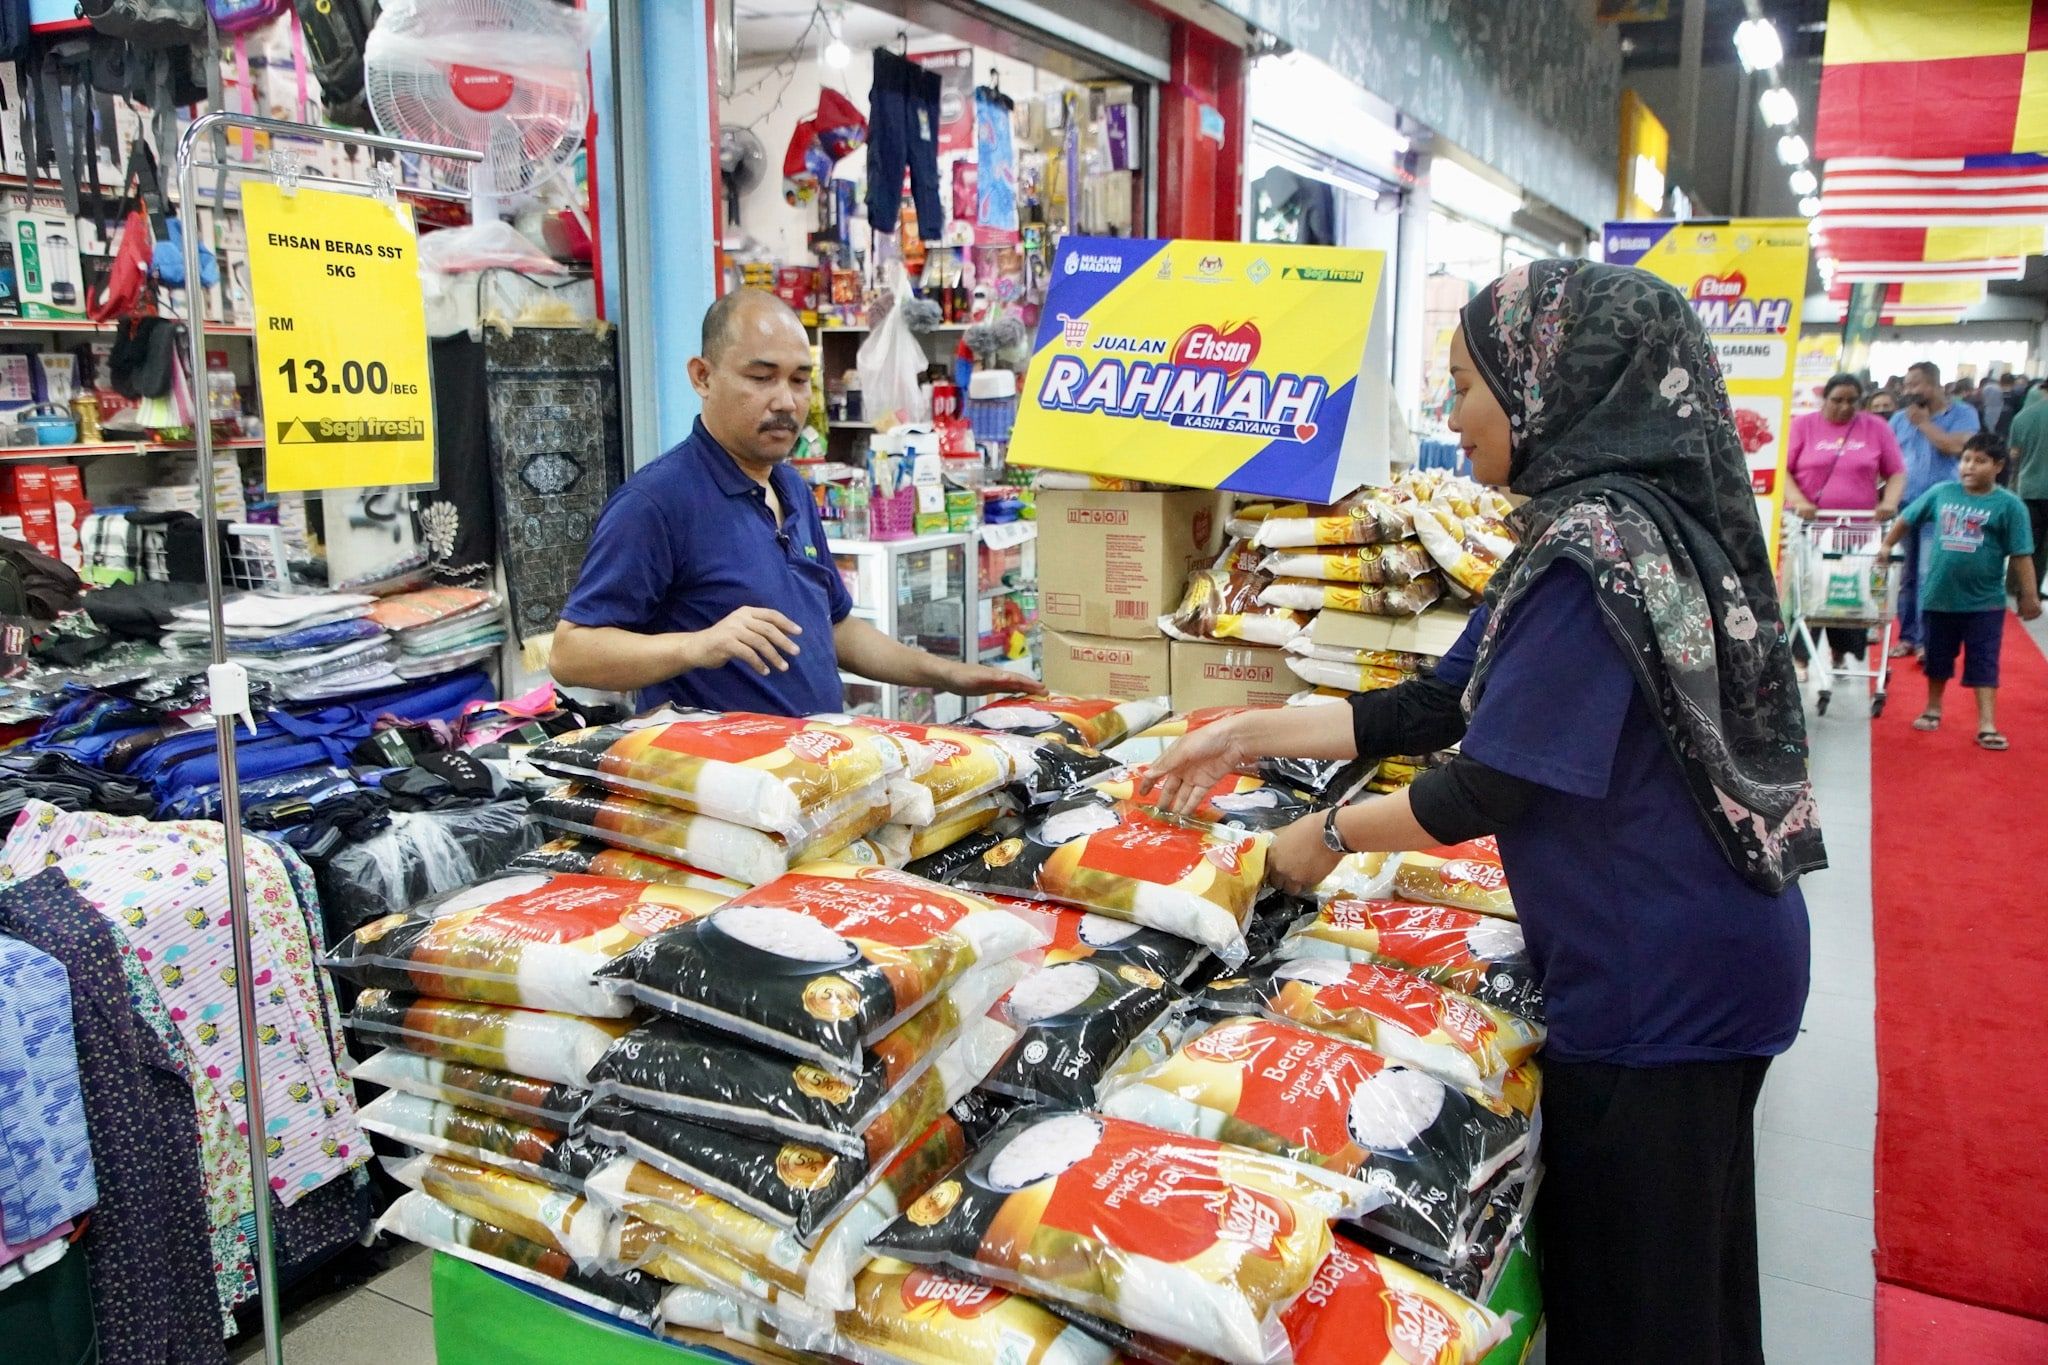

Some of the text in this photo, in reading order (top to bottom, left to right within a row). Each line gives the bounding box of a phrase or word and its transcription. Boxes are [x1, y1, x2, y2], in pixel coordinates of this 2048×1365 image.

[268, 233, 403, 259] EHSAN BERAS SST
[326, 264, 356, 278] 5KG
[1079, 262, 1121, 274] MADANI
[1081, 254, 1122, 265] MALAYSIA
[1700, 278, 1742, 296] Ehsan
[269, 317, 294, 331] RM
[1093, 336, 1166, 354] JUALAN
[1185, 332, 1251, 363] Ehsan
[1722, 345, 1771, 356] GARANG
[278, 358, 388, 394] 13.00
[1041, 356, 1329, 424] RAHMAH
[320, 416, 423, 441] Segi fresh
[1184, 414, 1281, 436] KASIH SAYANG
[1063, 1048, 1091, 1080] 5kg
[1262, 1039, 1315, 1082] Beras
[1281, 1041, 1344, 1104] Super Special
[811, 1074, 834, 1091] 5%
[794, 1153, 818, 1172] 5%
[1093, 1147, 1149, 1190] Tempatan
[1104, 1168, 1148, 1209] Special
[915, 1279, 993, 1308] Ehsan
[1307, 1253, 1360, 1308] Beras
[1420, 1303, 1449, 1358] Ehsan
